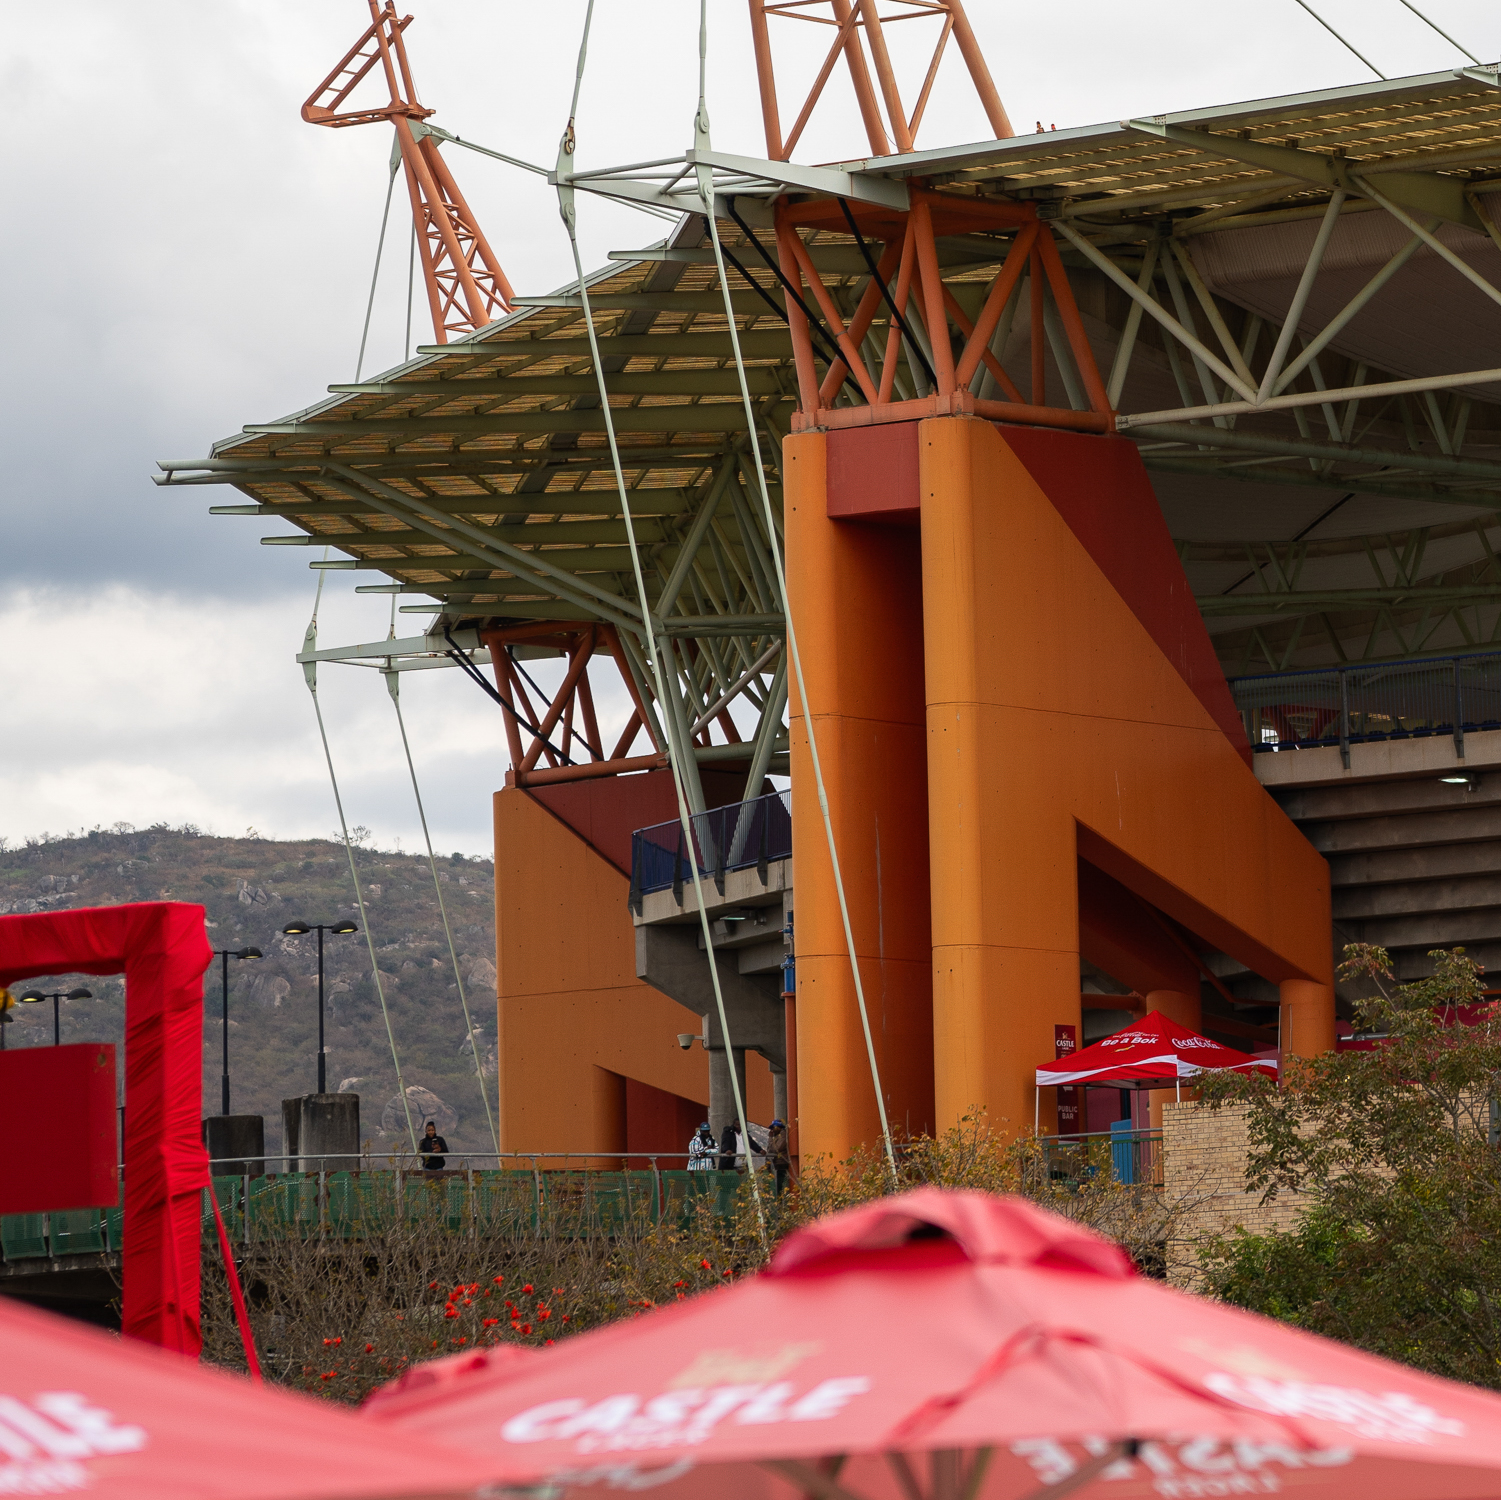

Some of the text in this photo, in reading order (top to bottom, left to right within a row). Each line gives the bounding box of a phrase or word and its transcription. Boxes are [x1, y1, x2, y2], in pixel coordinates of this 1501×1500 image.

[1056, 1039, 1075, 1048] CASTLE
[1058, 1105, 1078, 1113] PUBLIC
[1062, 1112, 1074, 1120] BAR
[500, 1374, 872, 1443] CASTLE
